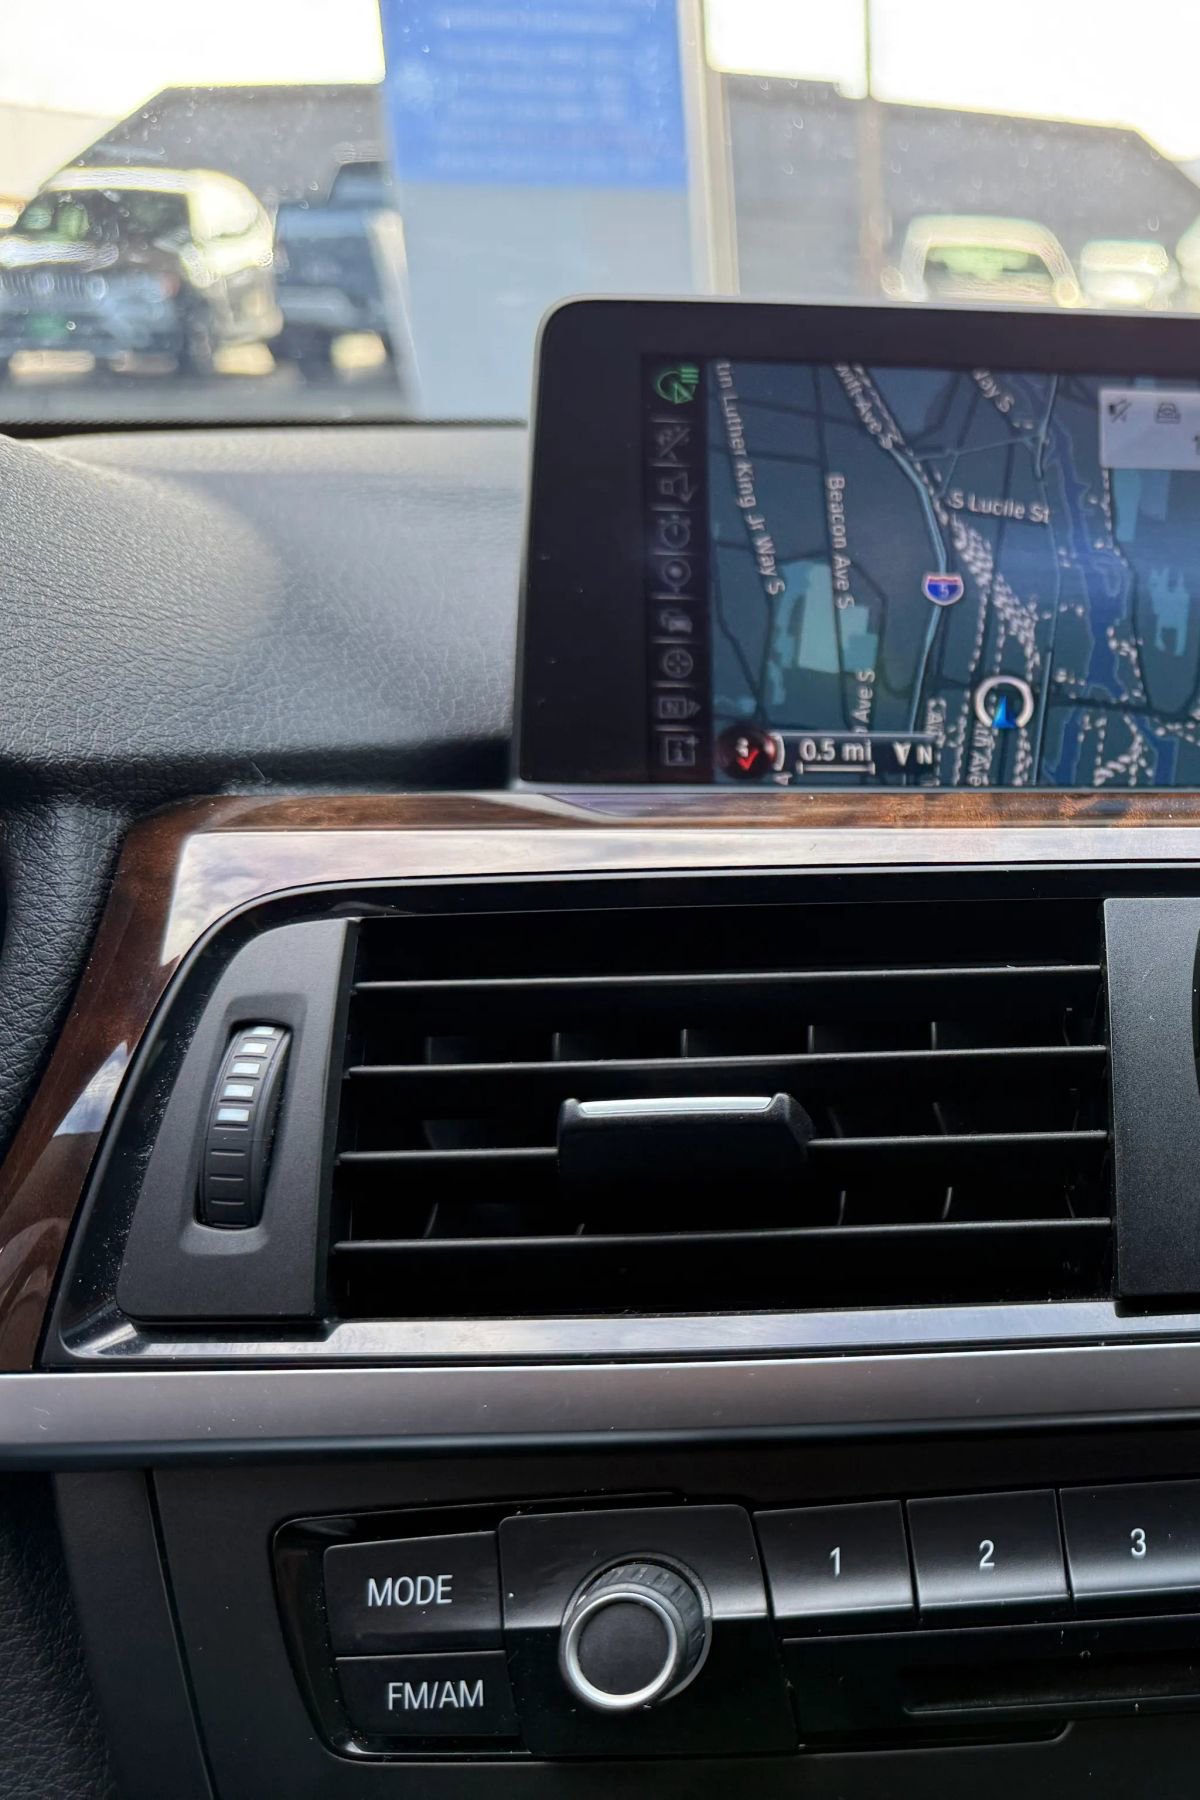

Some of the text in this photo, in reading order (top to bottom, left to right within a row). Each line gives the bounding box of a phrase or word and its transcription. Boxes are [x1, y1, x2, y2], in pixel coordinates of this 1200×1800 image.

[996, 393, 1015, 413] S
[723, 395, 746, 456] Luther
[736, 461, 756, 508] King
[744, 513, 765, 531] Jr
[947, 489, 1050, 524] S Lucile St
[755, 535, 778, 577] Way
[826, 472, 855, 610] Beacon Ave S
[765, 578, 786, 595] S
[858, 669, 876, 684] S
[852, 685, 874, 725] Ave
[799, 737, 933, 765] 0.5 mi N
[978, 1538, 996, 1570] 2
[1130, 1527, 1148, 1557] 3
[829, 1546, 841, 1577] 1
[367, 1574, 453, 1607] MODE
[387, 1679, 484, 1711] FM/AM
